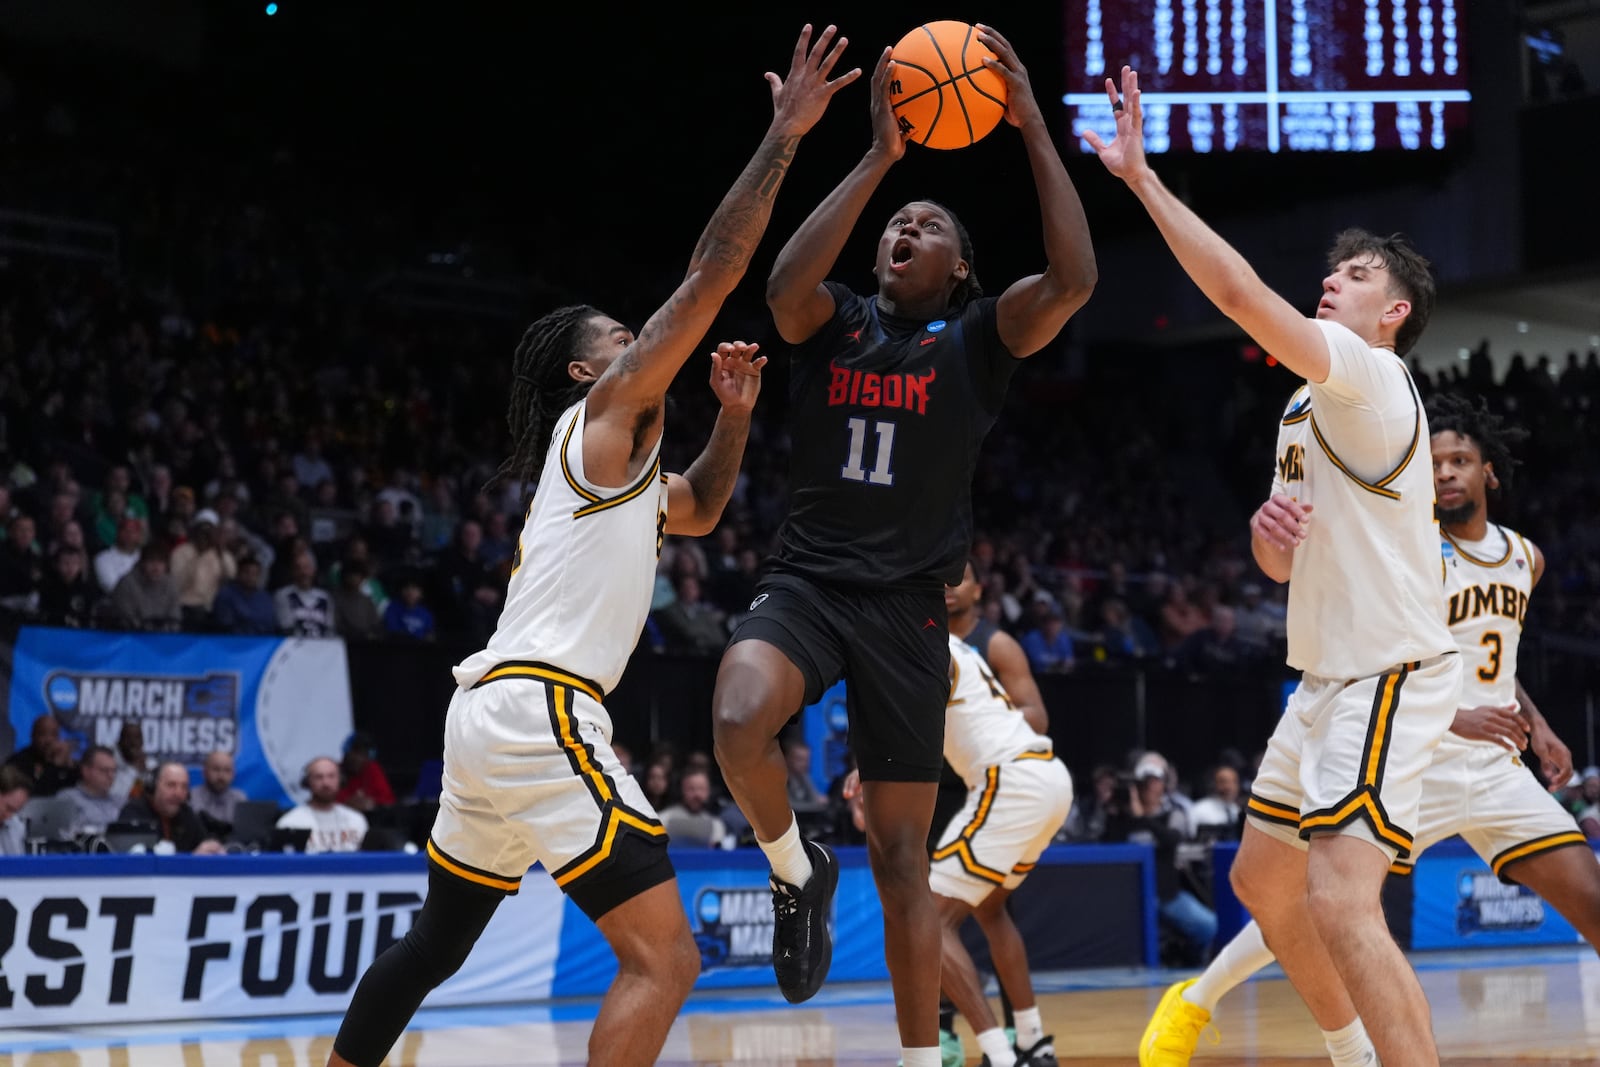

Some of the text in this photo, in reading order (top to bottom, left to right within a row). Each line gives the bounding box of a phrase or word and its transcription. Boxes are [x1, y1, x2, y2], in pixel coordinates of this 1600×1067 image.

[828, 359, 936, 415] BISON
[841, 416, 896, 486] 11
[1477, 630, 1503, 683] 3
[79, 678, 184, 716] MARCH
[95, 717, 235, 754] MDNESS
